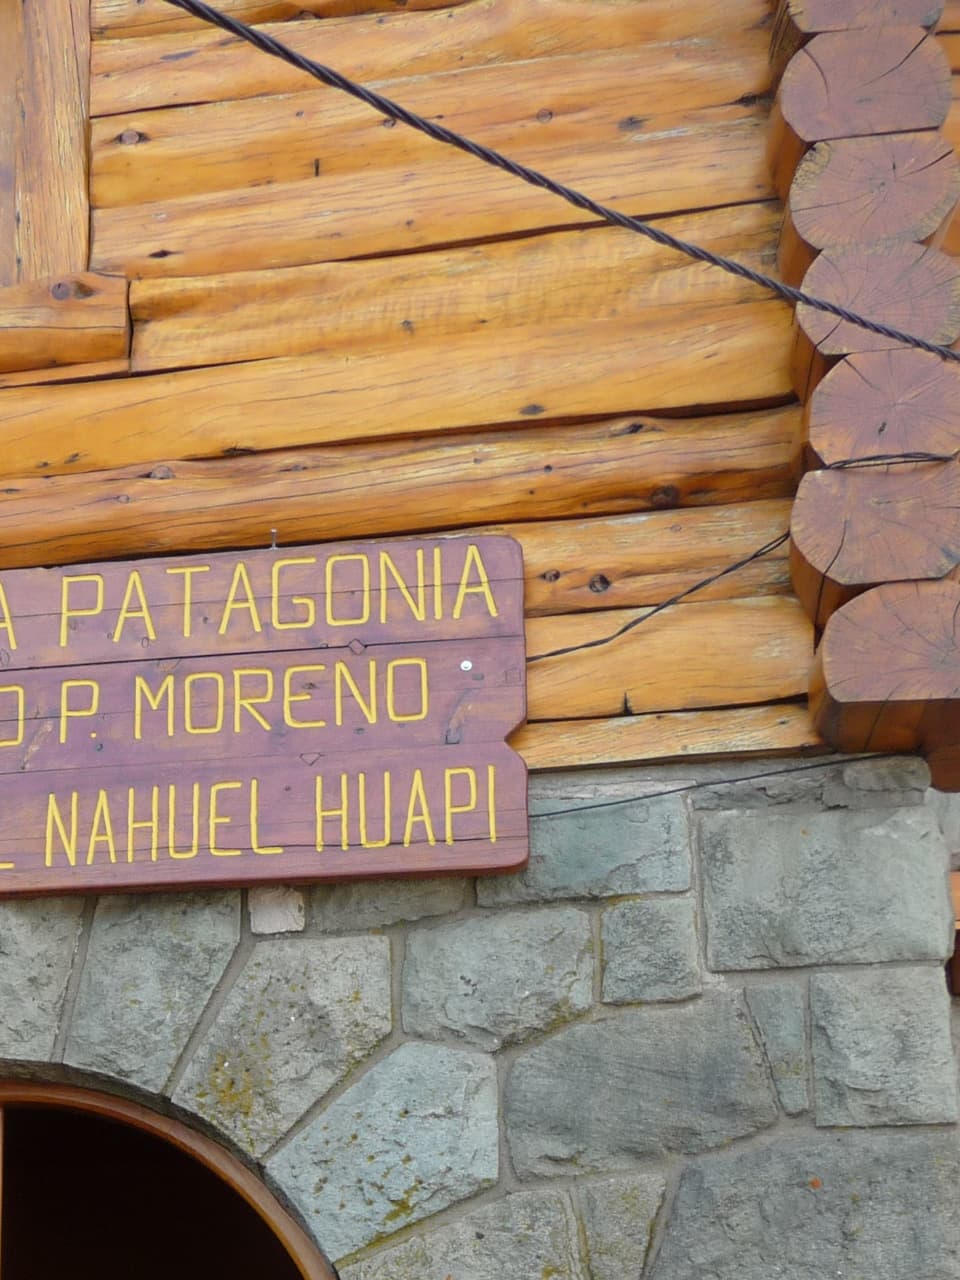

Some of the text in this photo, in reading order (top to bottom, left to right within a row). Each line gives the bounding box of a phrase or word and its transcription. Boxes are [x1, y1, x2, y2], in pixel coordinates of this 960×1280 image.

[58, 543, 499, 648] PATAGONIA
[58, 678, 100, 744] P.
[133, 656, 429, 741] MORENO
[44, 777, 284, 869] NAHUEL
[314, 764, 497, 853] HUAPI
